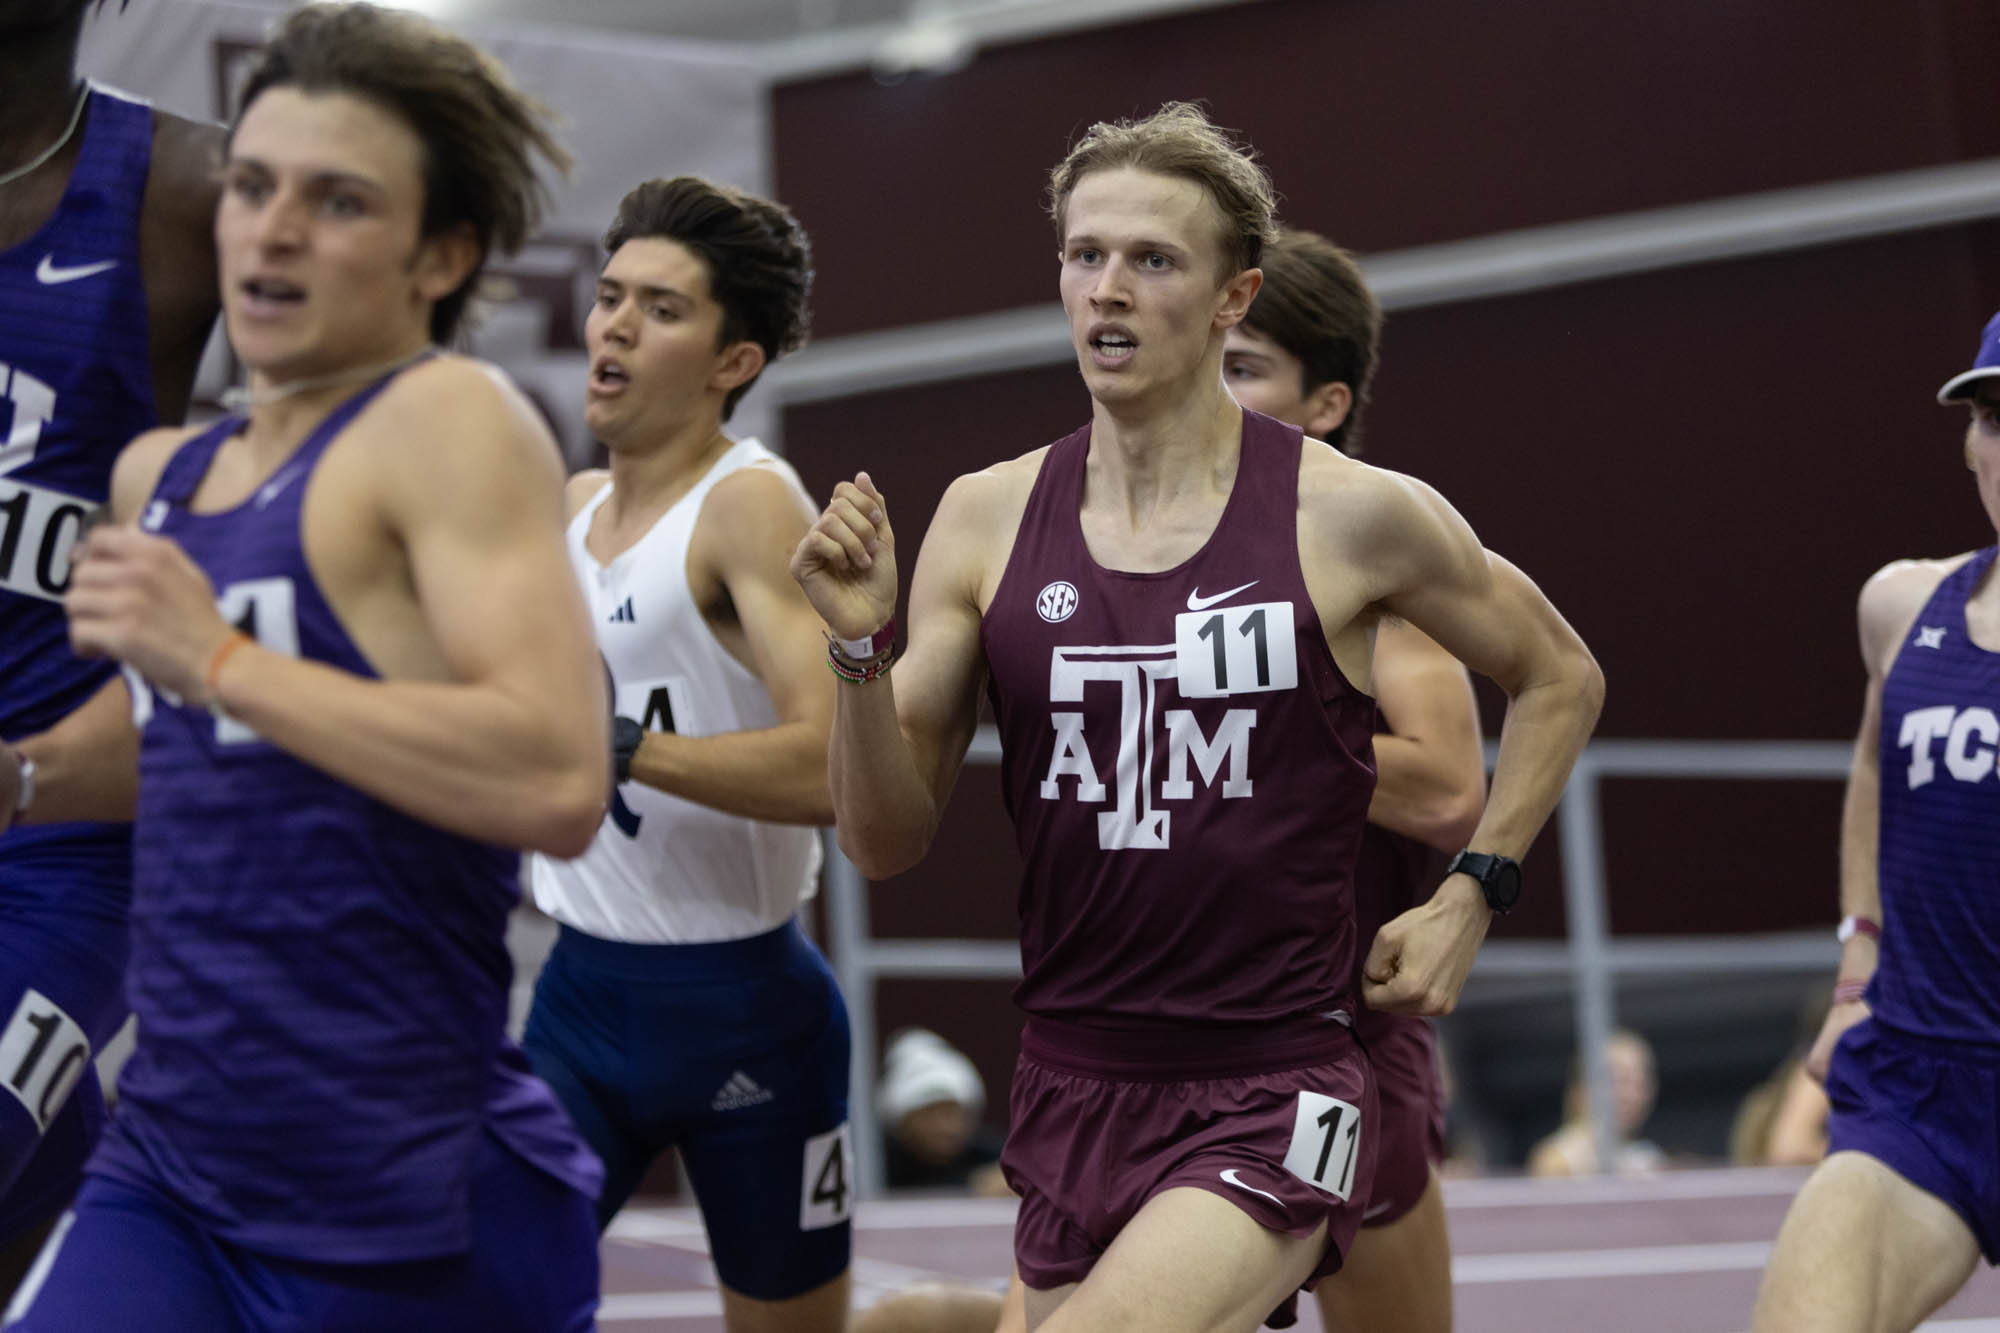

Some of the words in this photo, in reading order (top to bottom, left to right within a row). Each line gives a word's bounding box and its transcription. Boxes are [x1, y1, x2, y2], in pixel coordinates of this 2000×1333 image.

[0, 490, 86, 595] 10
[1040, 584, 1076, 619] SEC
[1197, 609, 1270, 689] 11
[1898, 705, 2000, 790] TC
[11, 1012, 88, 1125] 10
[811, 1136, 846, 1213] 4
[1313, 1105, 1360, 1193] 11
